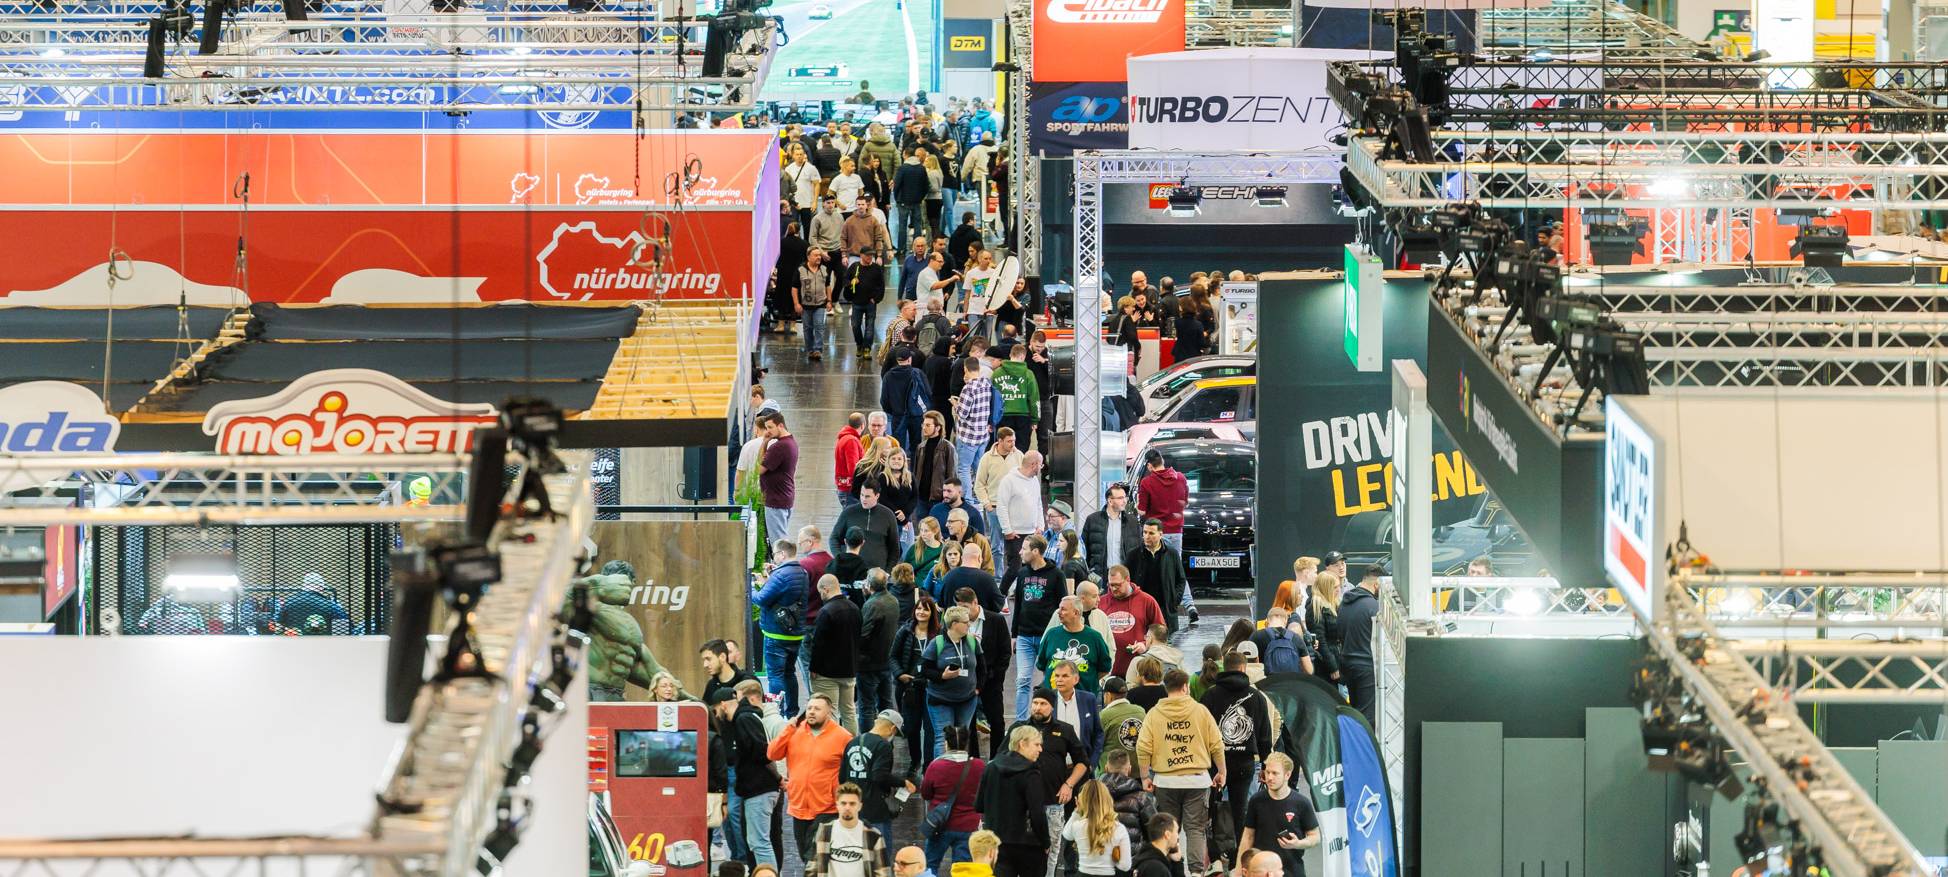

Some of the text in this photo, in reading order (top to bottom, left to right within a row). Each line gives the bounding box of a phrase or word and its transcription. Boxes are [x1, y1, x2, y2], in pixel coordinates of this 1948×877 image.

[954, 39, 981, 48] DTM
[586, 187, 634, 198] nürburgring
[693, 187, 742, 198] nürburgring
[1201, 185, 1288, 200] ECHN
[573, 267, 721, 295] nürburgring
[1302, 408, 1393, 470] DRIV
[1195, 558, 1206, 567] KB
[628, 579, 690, 611] ring
[1167, 721, 1191, 731] NEED
[1164, 733, 1195, 744] MONEY
[1171, 745, 1188, 756] FOR
[1167, 754, 1194, 768] BOOST
[627, 832, 666, 865] 60
